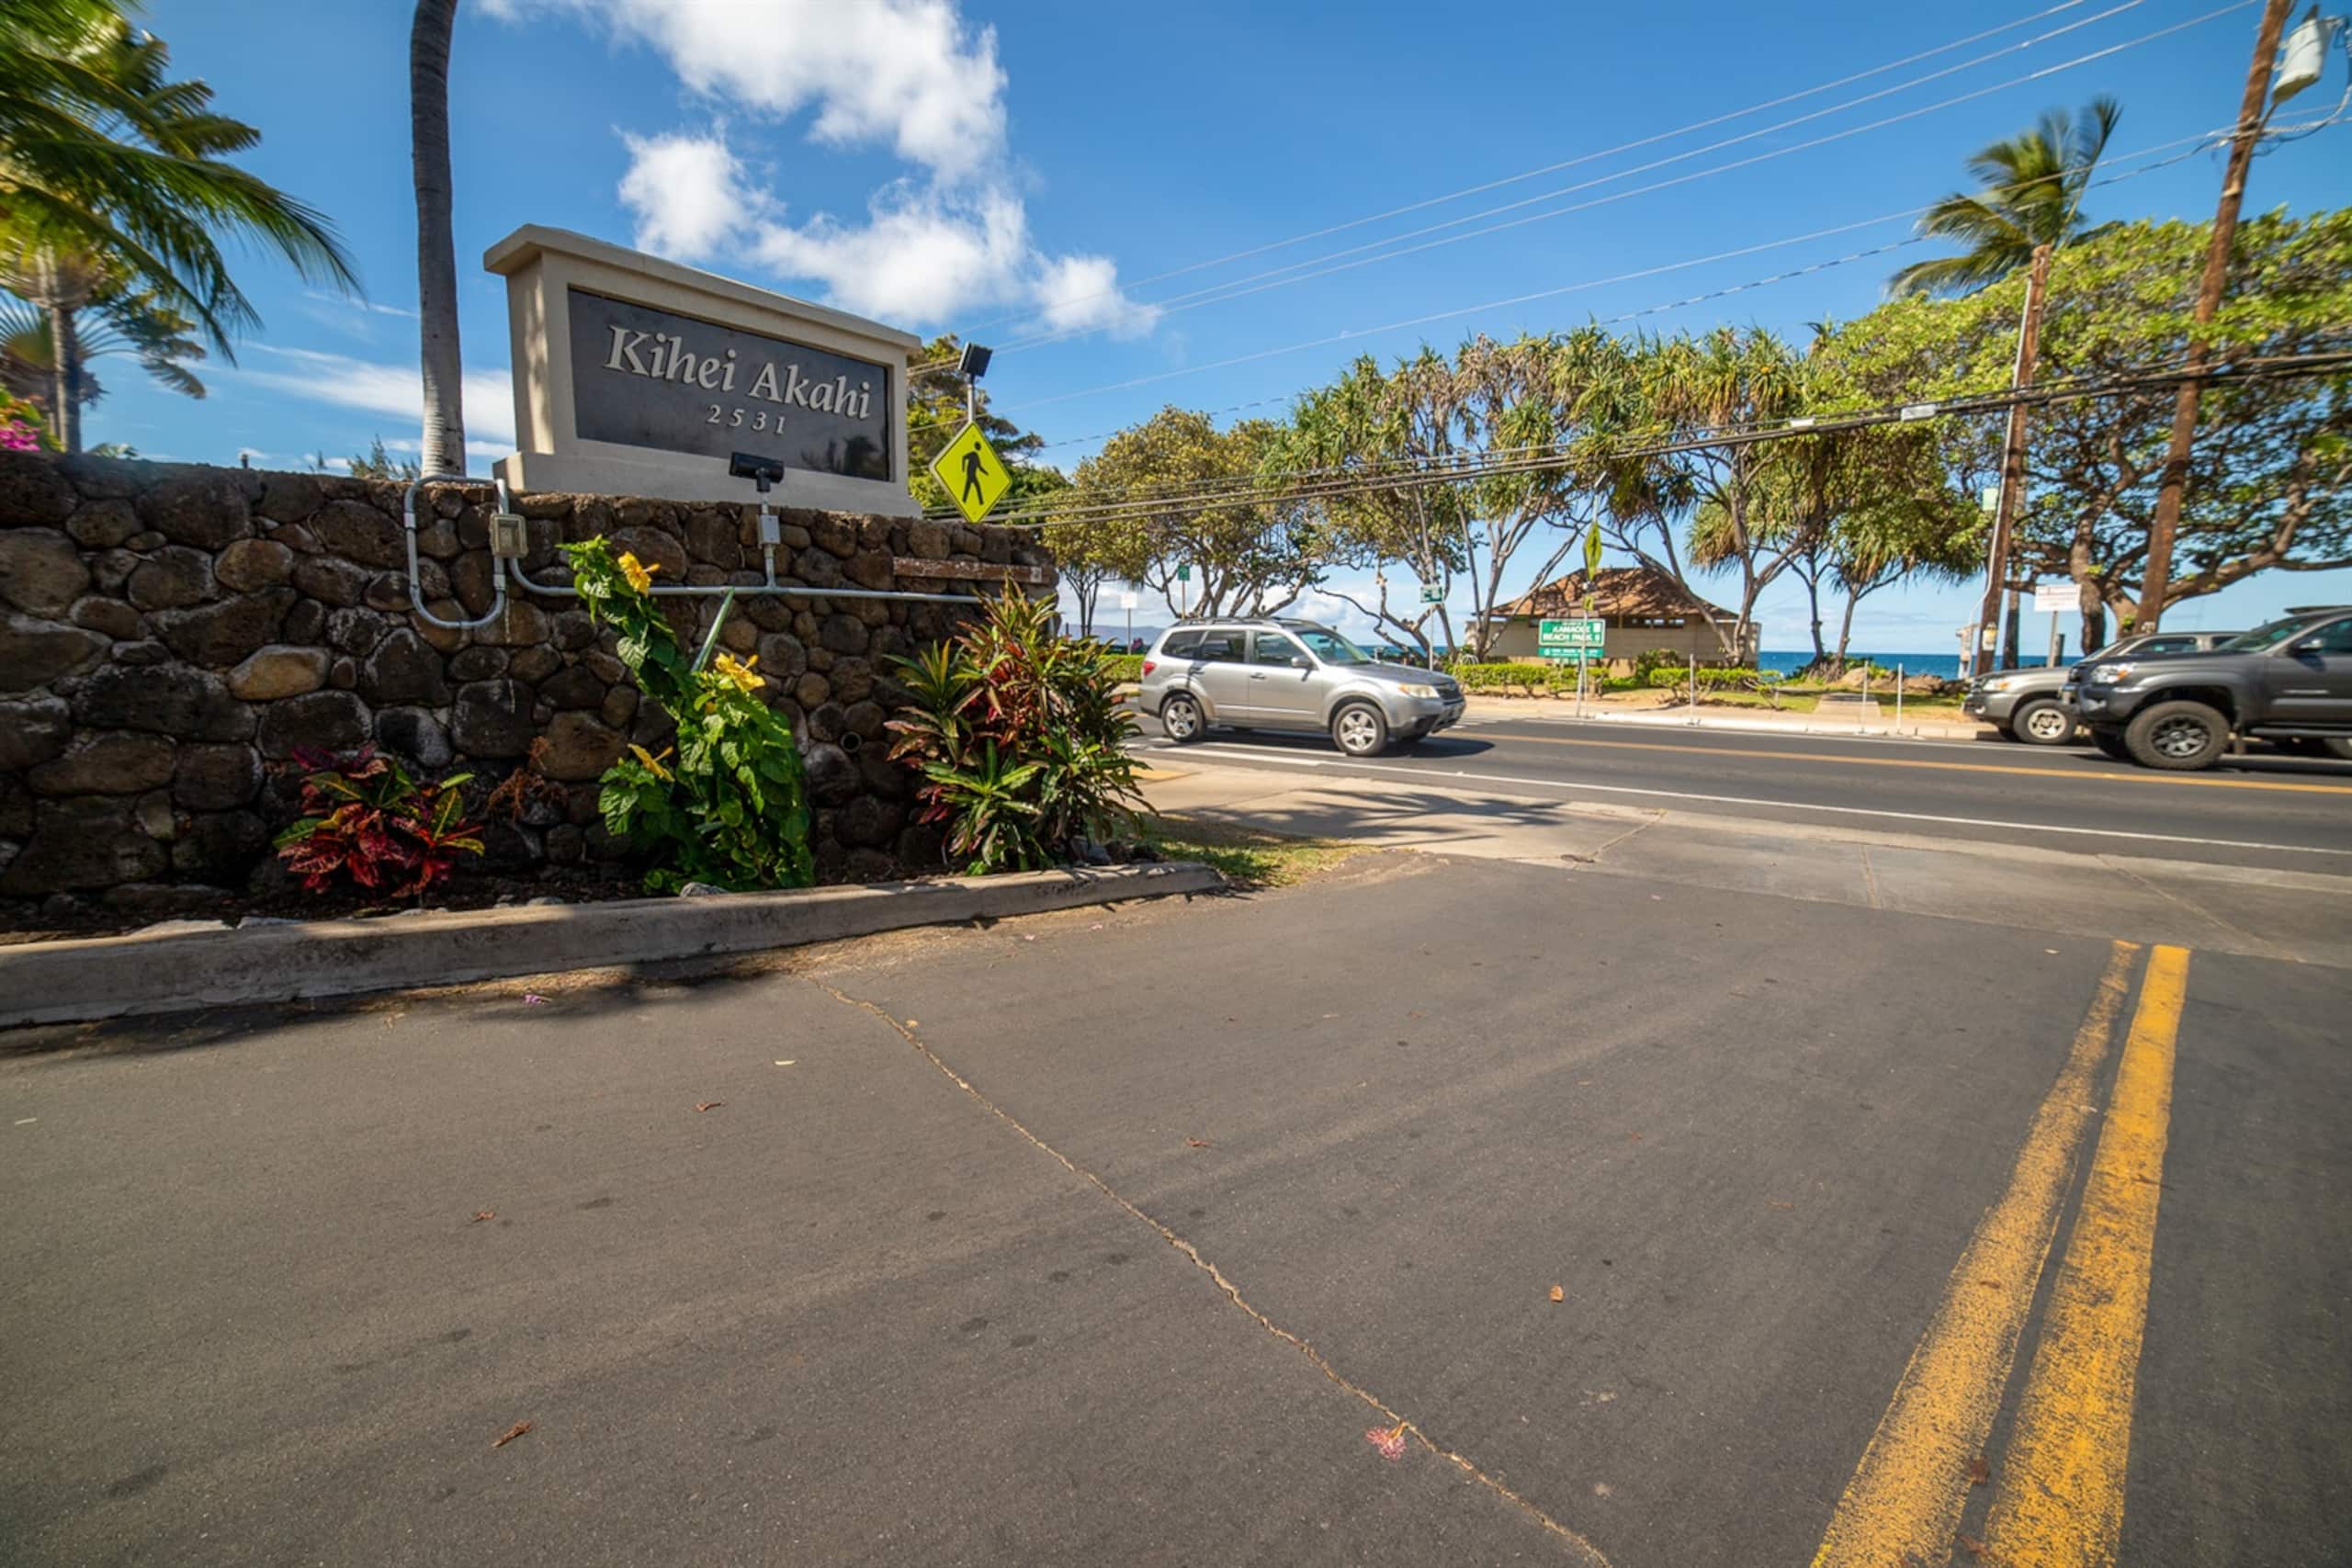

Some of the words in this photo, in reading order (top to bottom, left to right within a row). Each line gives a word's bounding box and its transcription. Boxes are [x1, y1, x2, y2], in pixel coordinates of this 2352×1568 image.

[602, 324, 737, 393] Kihei
[747, 362, 871, 421] Akahi
[706, 403, 786, 434] 2531
